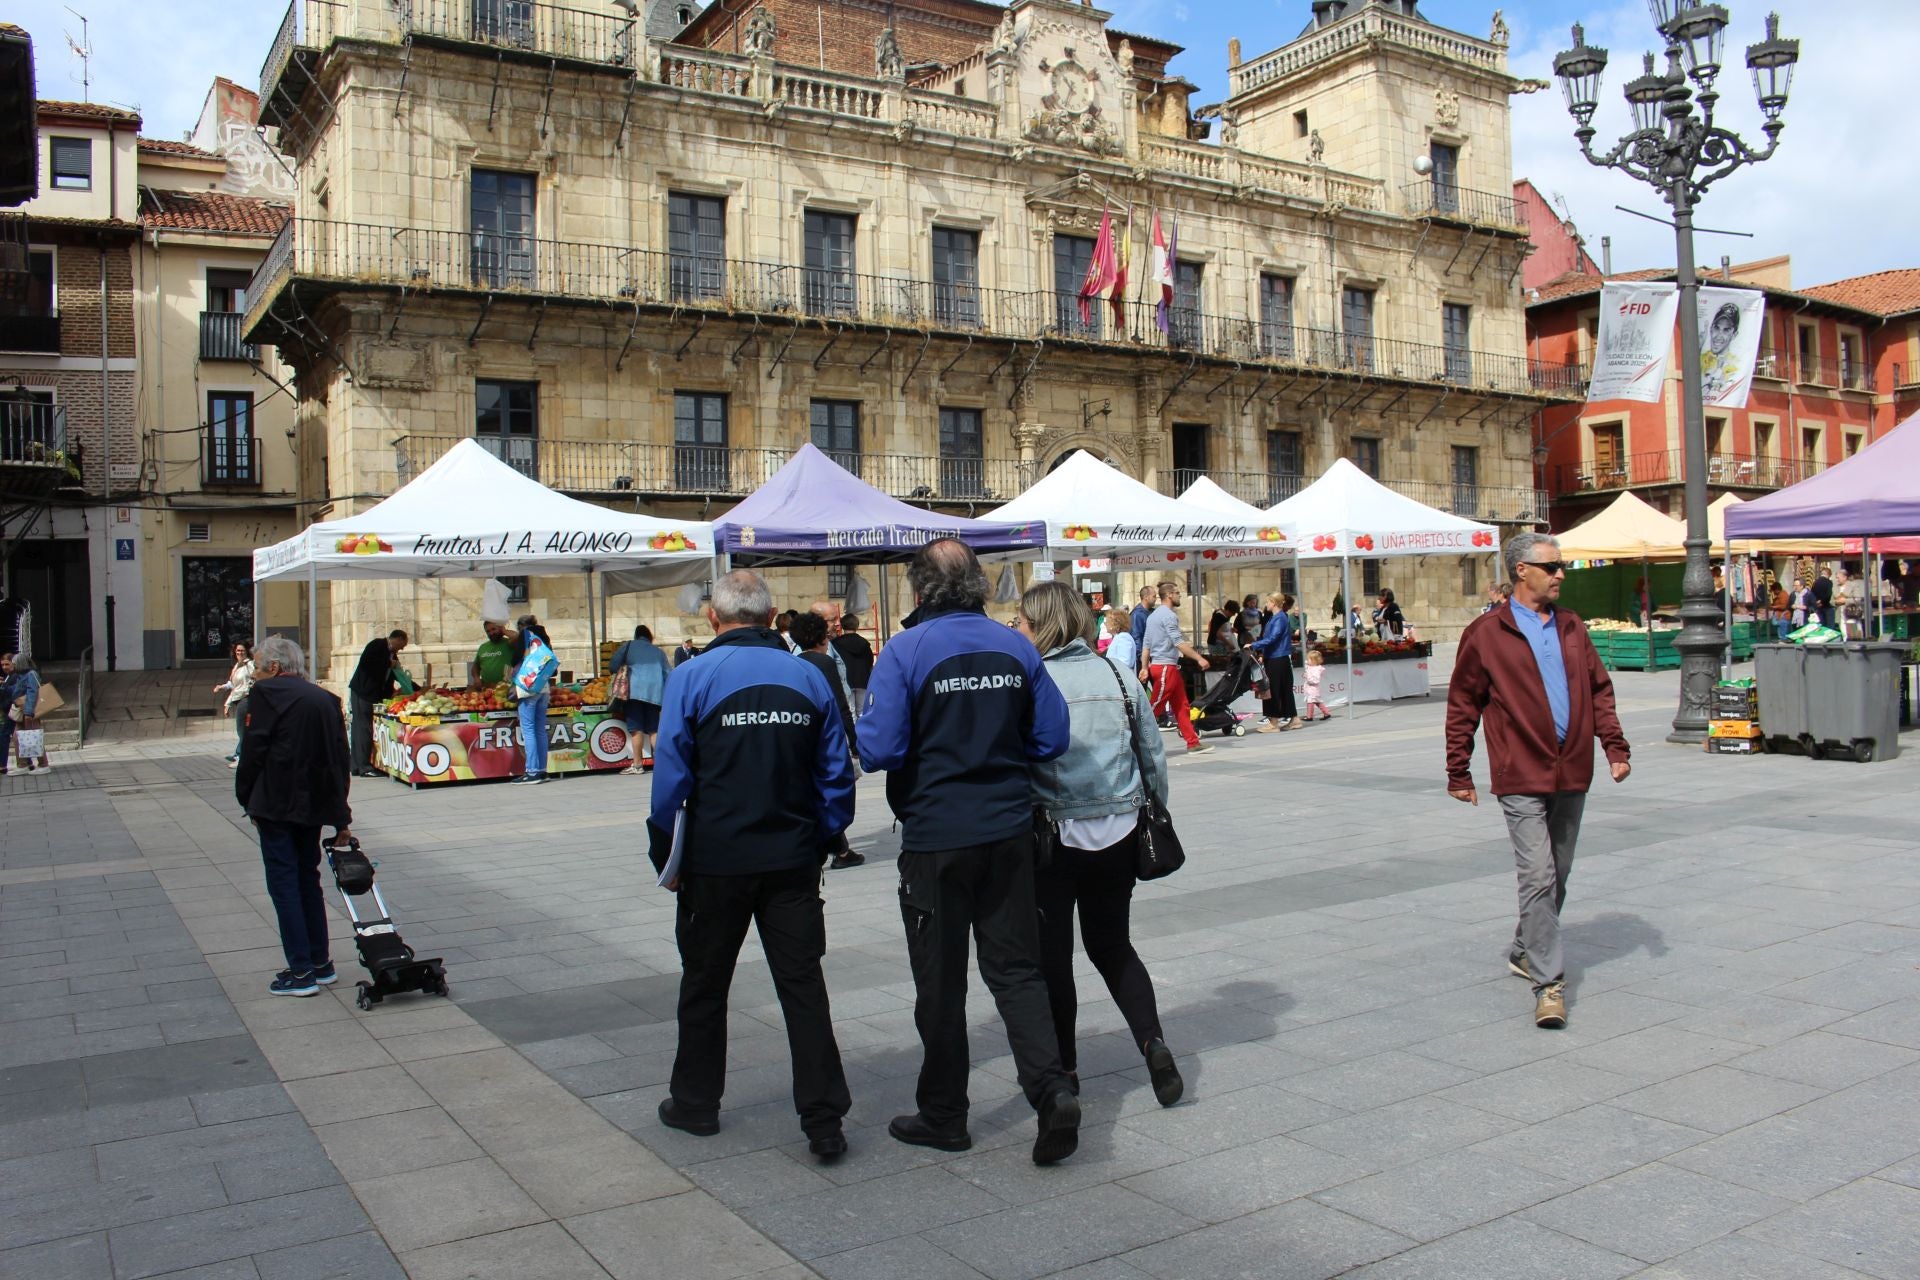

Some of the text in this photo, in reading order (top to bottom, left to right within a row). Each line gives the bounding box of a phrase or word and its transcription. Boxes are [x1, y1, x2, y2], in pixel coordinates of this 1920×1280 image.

[1629, 303, 1651, 315] FID
[827, 527, 884, 548] Mercado
[1111, 523, 1247, 543] Frutas J. A. ALONSO
[1381, 531, 1466, 549] UÑA PRIETO S.C.
[413, 531, 633, 556] Frutas J. A. ALONSO
[934, 674, 1023, 695] MERCADOS
[721, 711, 811, 727] MERCADOS
[479, 721, 588, 749] FRUAS
